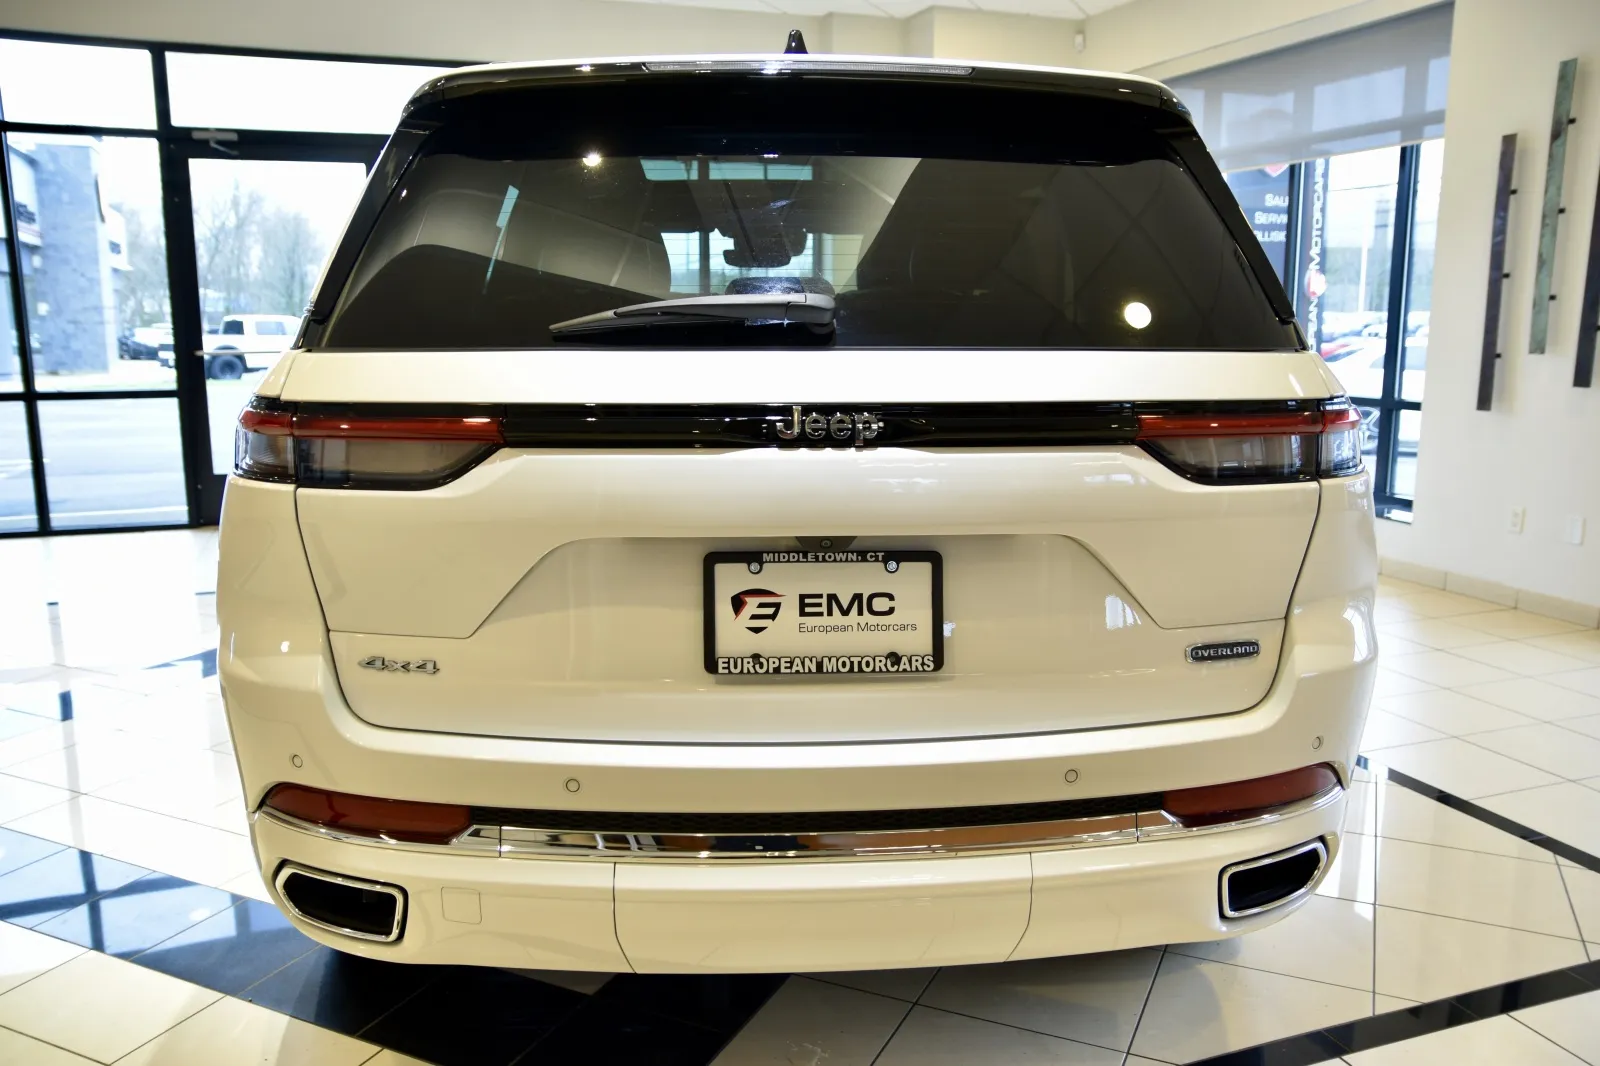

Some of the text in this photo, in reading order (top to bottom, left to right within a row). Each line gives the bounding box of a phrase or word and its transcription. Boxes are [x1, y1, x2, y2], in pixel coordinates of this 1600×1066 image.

[776, 405, 878, 446] Jeep
[762, 552, 885, 562] MIDDLETOWN, CT
[798, 592, 896, 617] EMC
[798, 622, 918, 634] European Motorcars
[1192, 645, 1258, 658] OVERLAND
[357, 656, 440, 674] 4x4
[717, 655, 935, 674] EUROPEAN MOTORCARS
